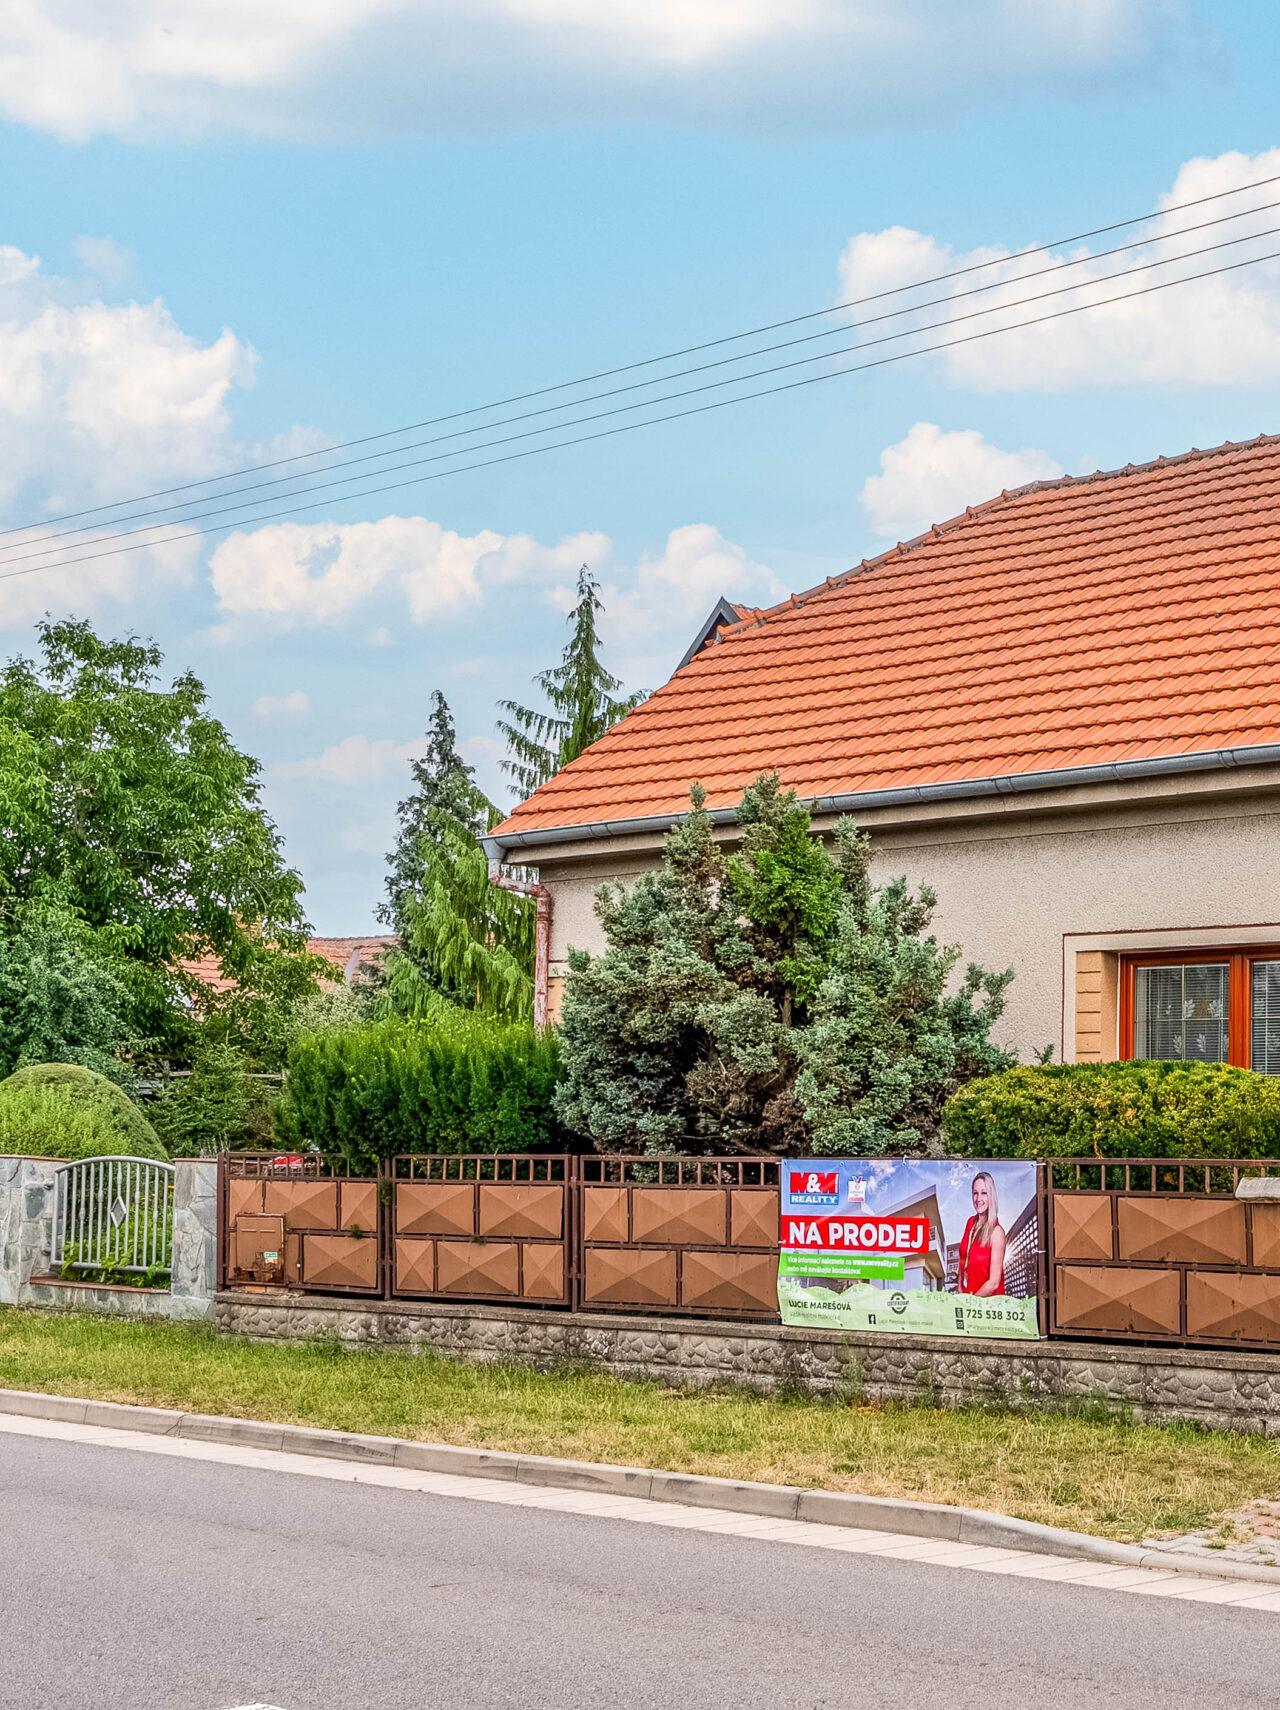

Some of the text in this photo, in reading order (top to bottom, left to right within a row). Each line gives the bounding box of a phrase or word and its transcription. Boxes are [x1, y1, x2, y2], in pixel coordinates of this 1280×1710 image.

[790, 1172, 836, 1194] M&M
[791, 1195, 837, 1204] REALITY
[789, 1221, 924, 1249] NA PRODEJ
[788, 1299, 852, 1311] LUCIE MAREŠOVÁ
[966, 1309, 1025, 1321] 725 538 302
